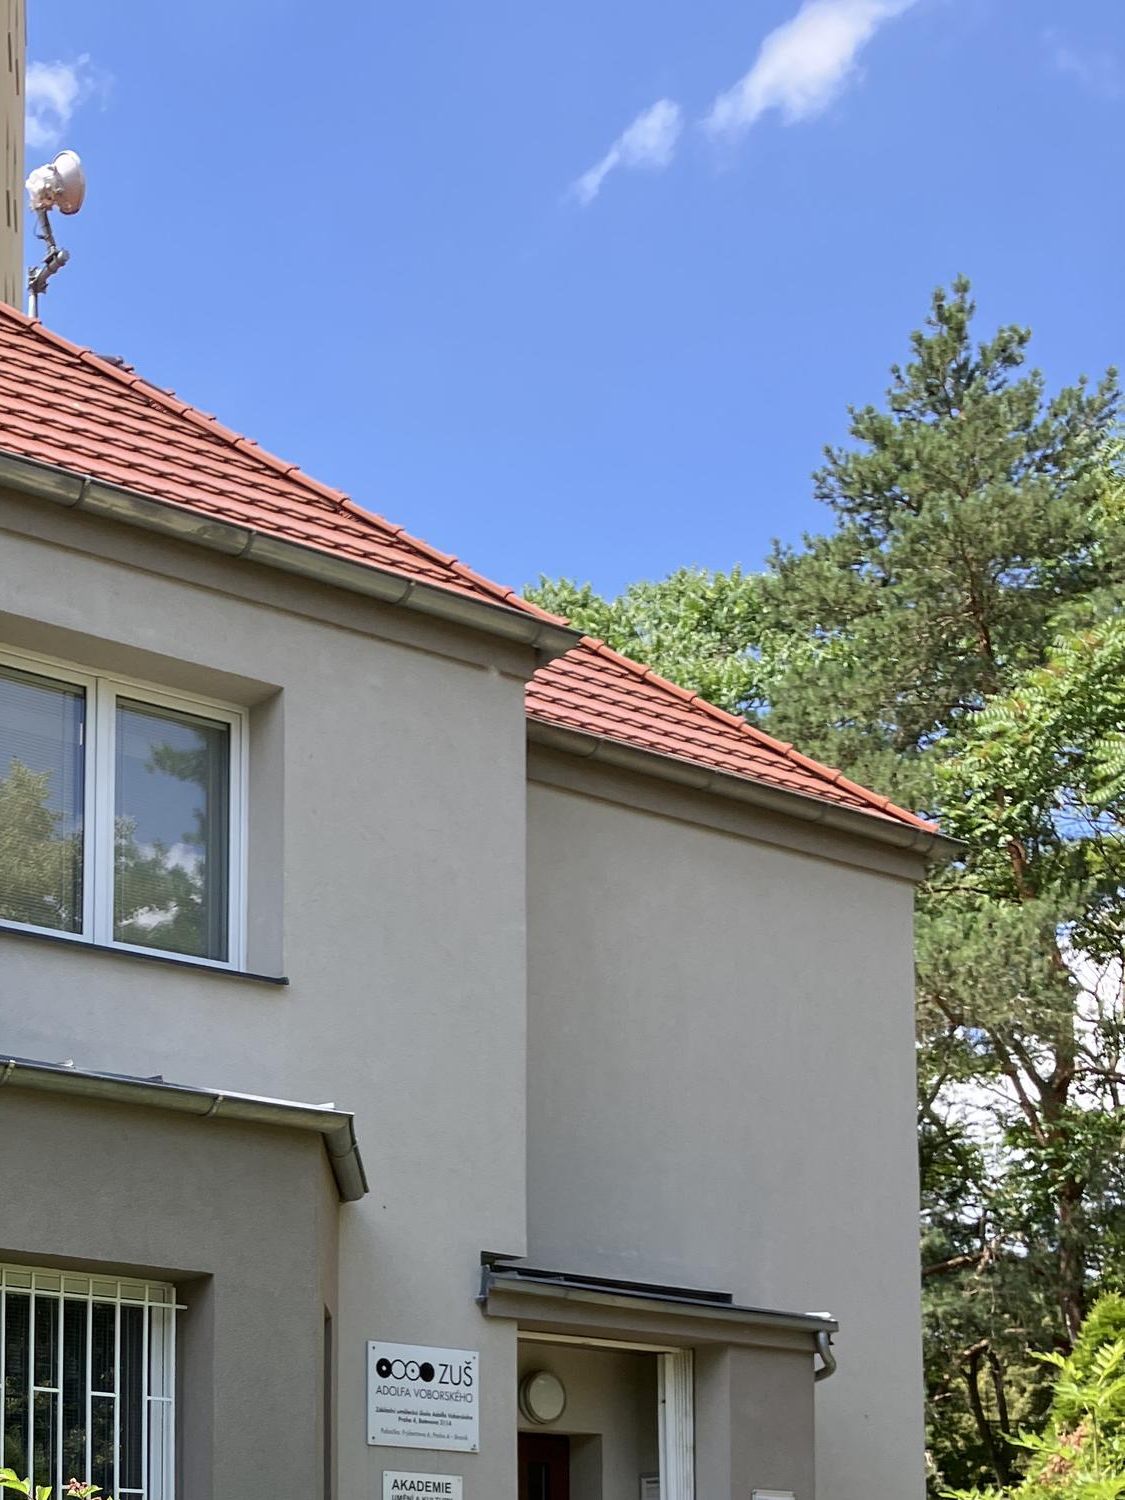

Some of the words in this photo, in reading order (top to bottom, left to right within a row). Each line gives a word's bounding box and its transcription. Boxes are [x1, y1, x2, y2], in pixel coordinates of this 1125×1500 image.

[439, 1360, 473, 1387] ZUŠ
[376, 1385, 411, 1397] ADOLFA
[413, 1388, 473, 1403] VOBORSKÉHO
[391, 1479, 452, 1493] AKADEMIE
